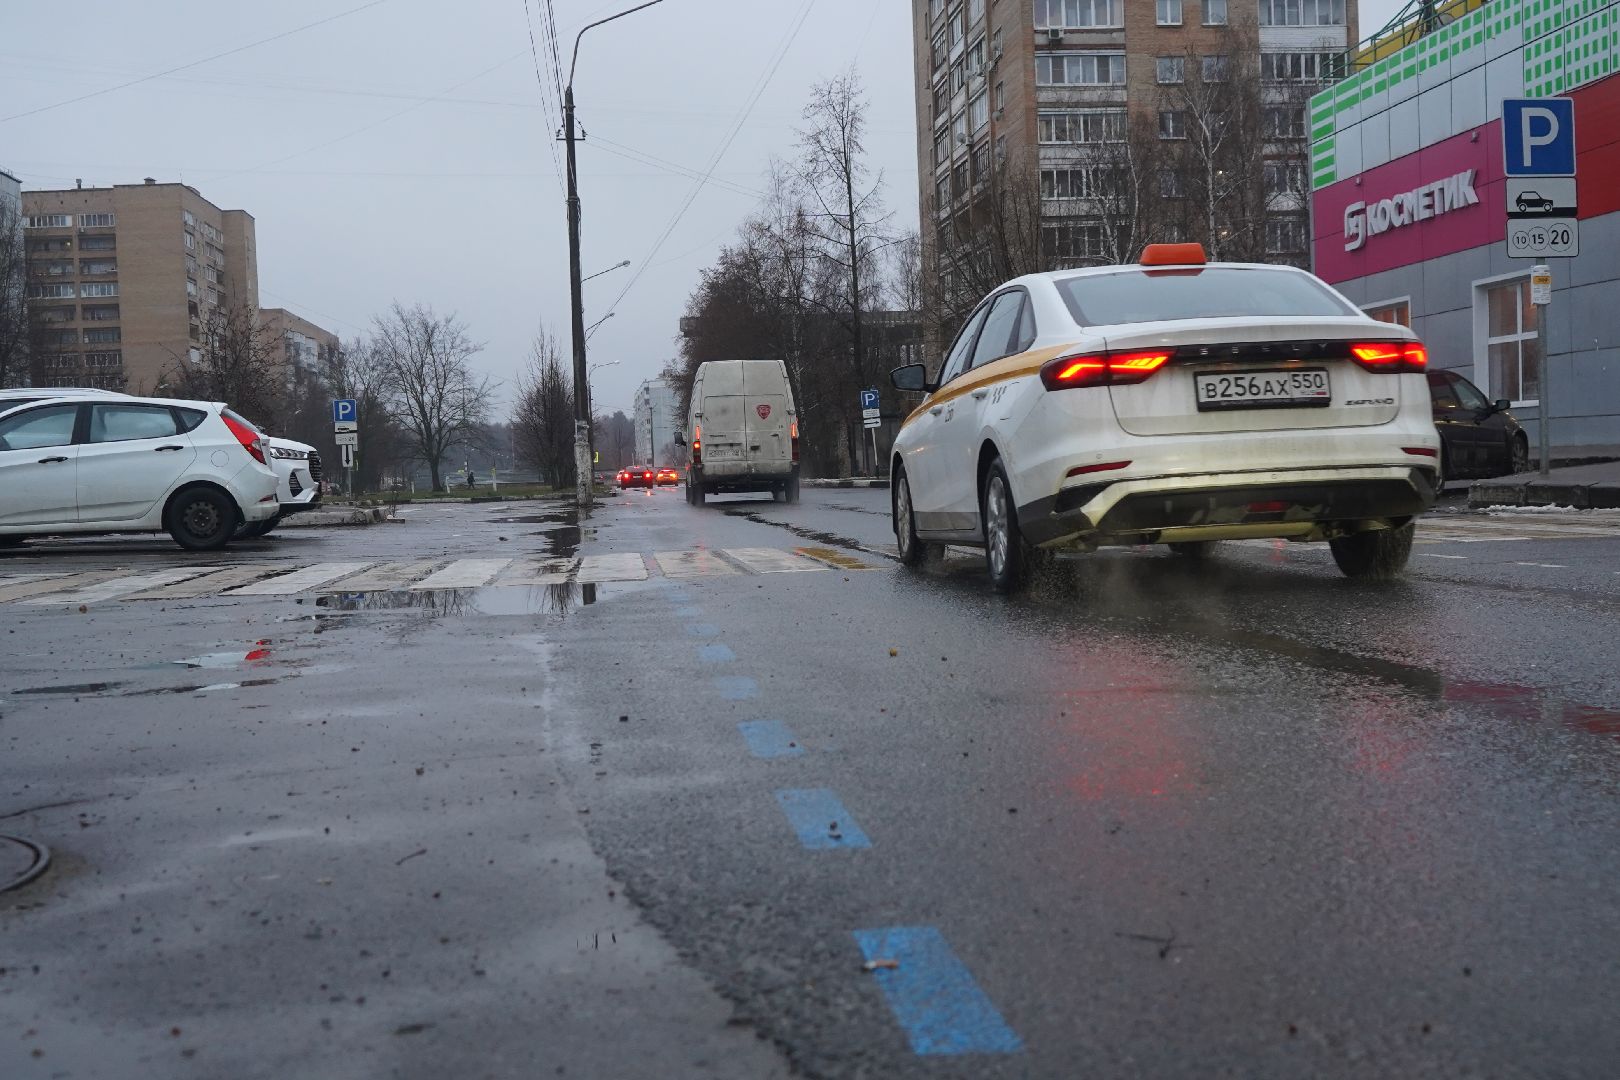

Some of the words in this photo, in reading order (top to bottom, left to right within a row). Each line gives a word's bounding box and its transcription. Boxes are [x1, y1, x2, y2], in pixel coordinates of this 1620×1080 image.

[1521, 107, 1559, 167] P
[1366, 168, 1479, 236] КОСМЕТИК
[1516, 236, 1527, 245] 10
[1532, 233, 1545, 245] 15
[1551, 229, 1570, 245] 20
[865, 393, 875, 406] P
[339, 402, 351, 420] P
